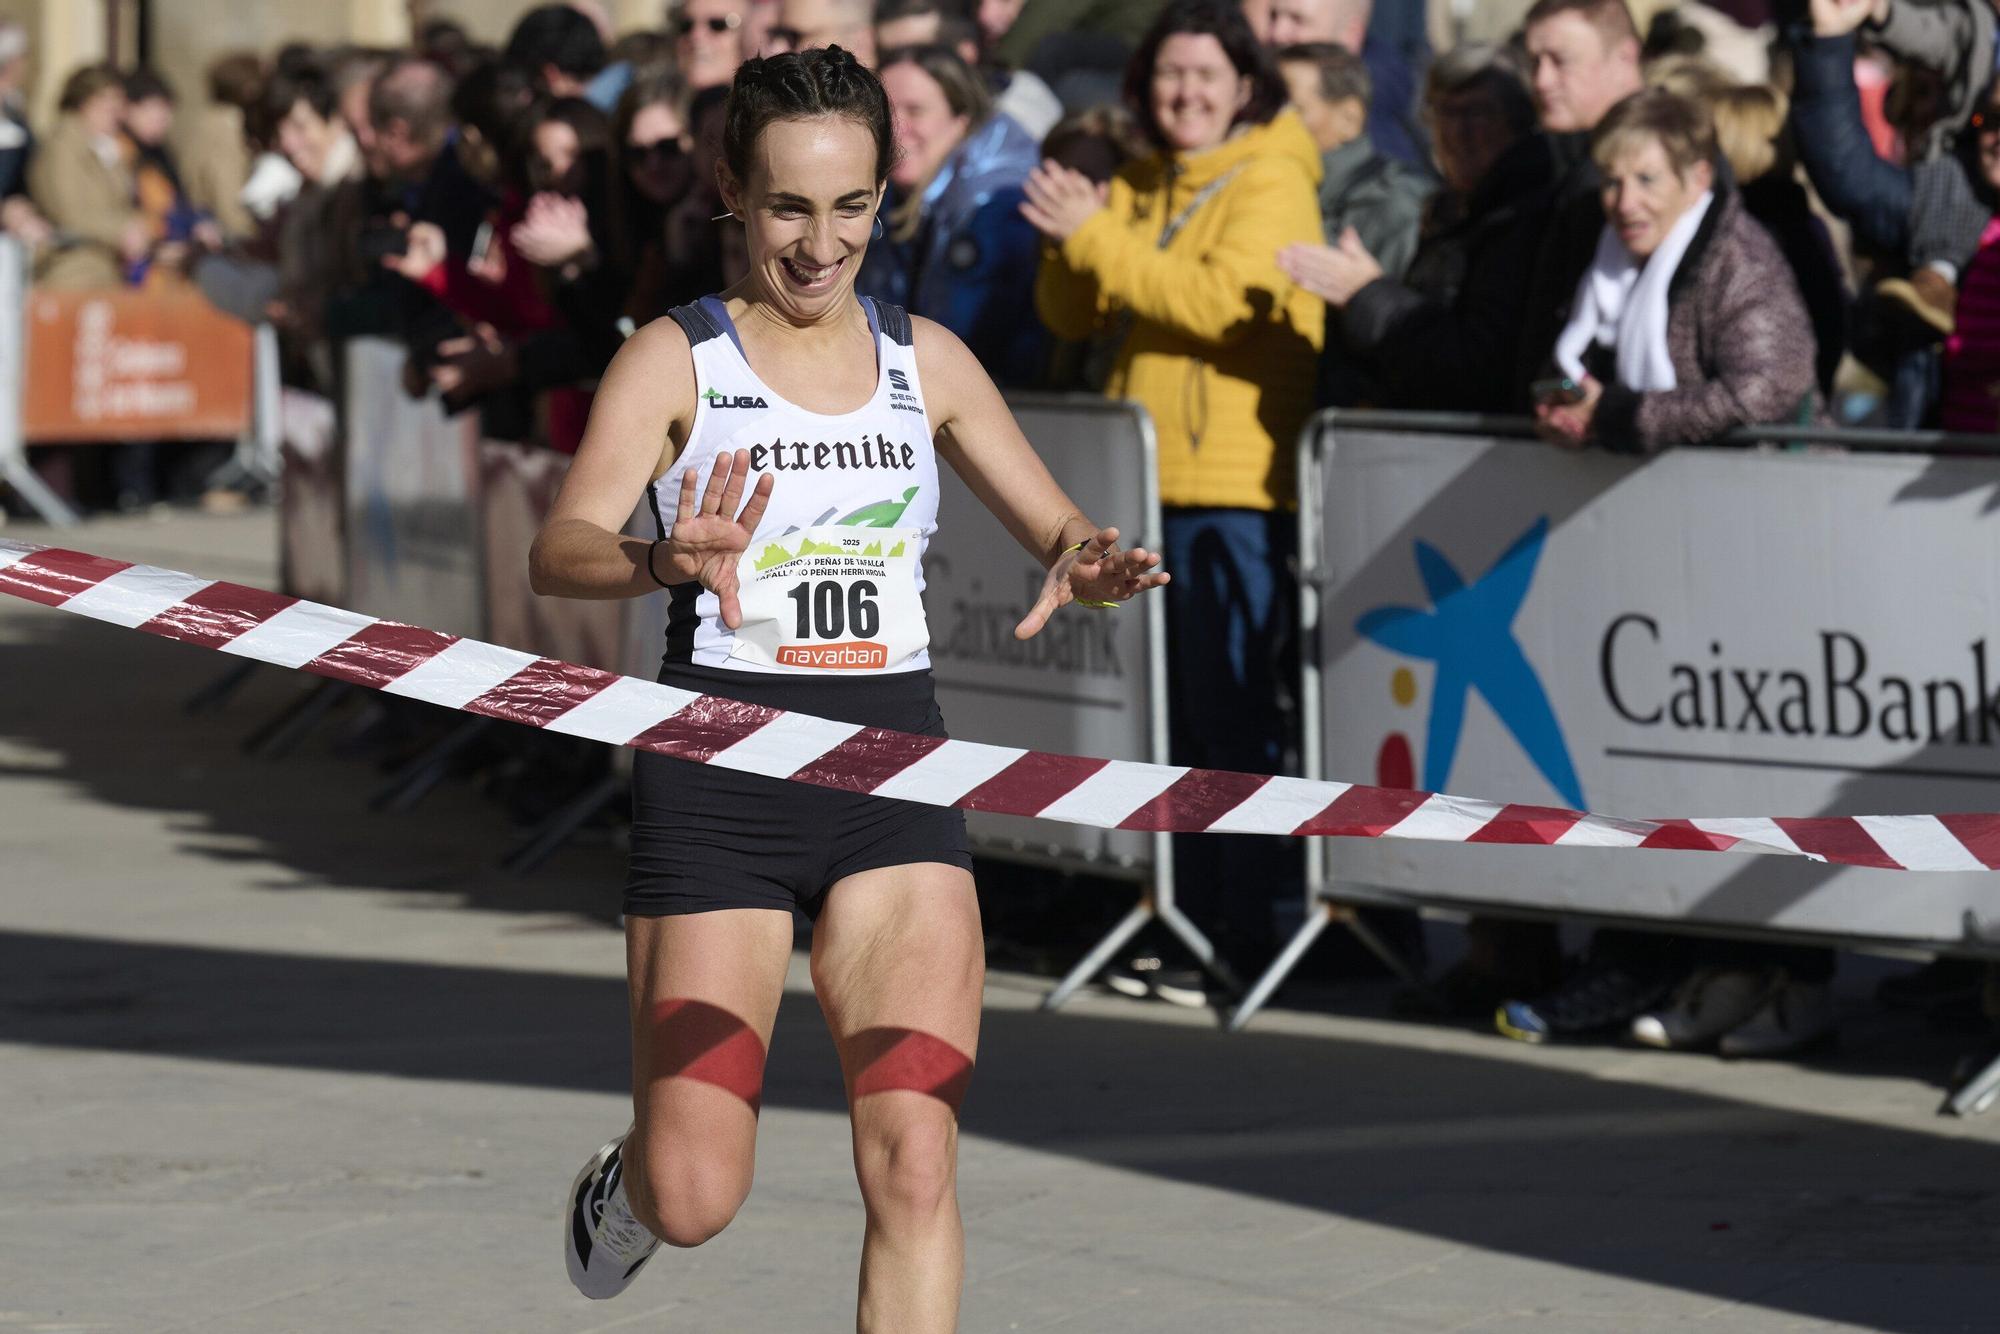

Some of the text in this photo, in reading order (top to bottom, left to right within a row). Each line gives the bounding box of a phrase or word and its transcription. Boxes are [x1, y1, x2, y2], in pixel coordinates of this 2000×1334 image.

[709, 396, 769, 409] LUGA
[890, 394, 917, 403] SEAT
[750, 433, 915, 472] etxenike
[842, 538, 860, 546] 2025
[814, 556, 841, 566] PEÑAS
[844, 558, 855, 566] DE
[856, 559, 885, 568] TAFALLA
[810, 567, 839, 576] PEÑEN
[840, 568, 864, 576] HERRI
[865, 569, 887, 578] KROSA
[787, 579, 880, 640] 106
[783, 646, 882, 664] navarban
[1599, 612, 2000, 746] CaixaBank
